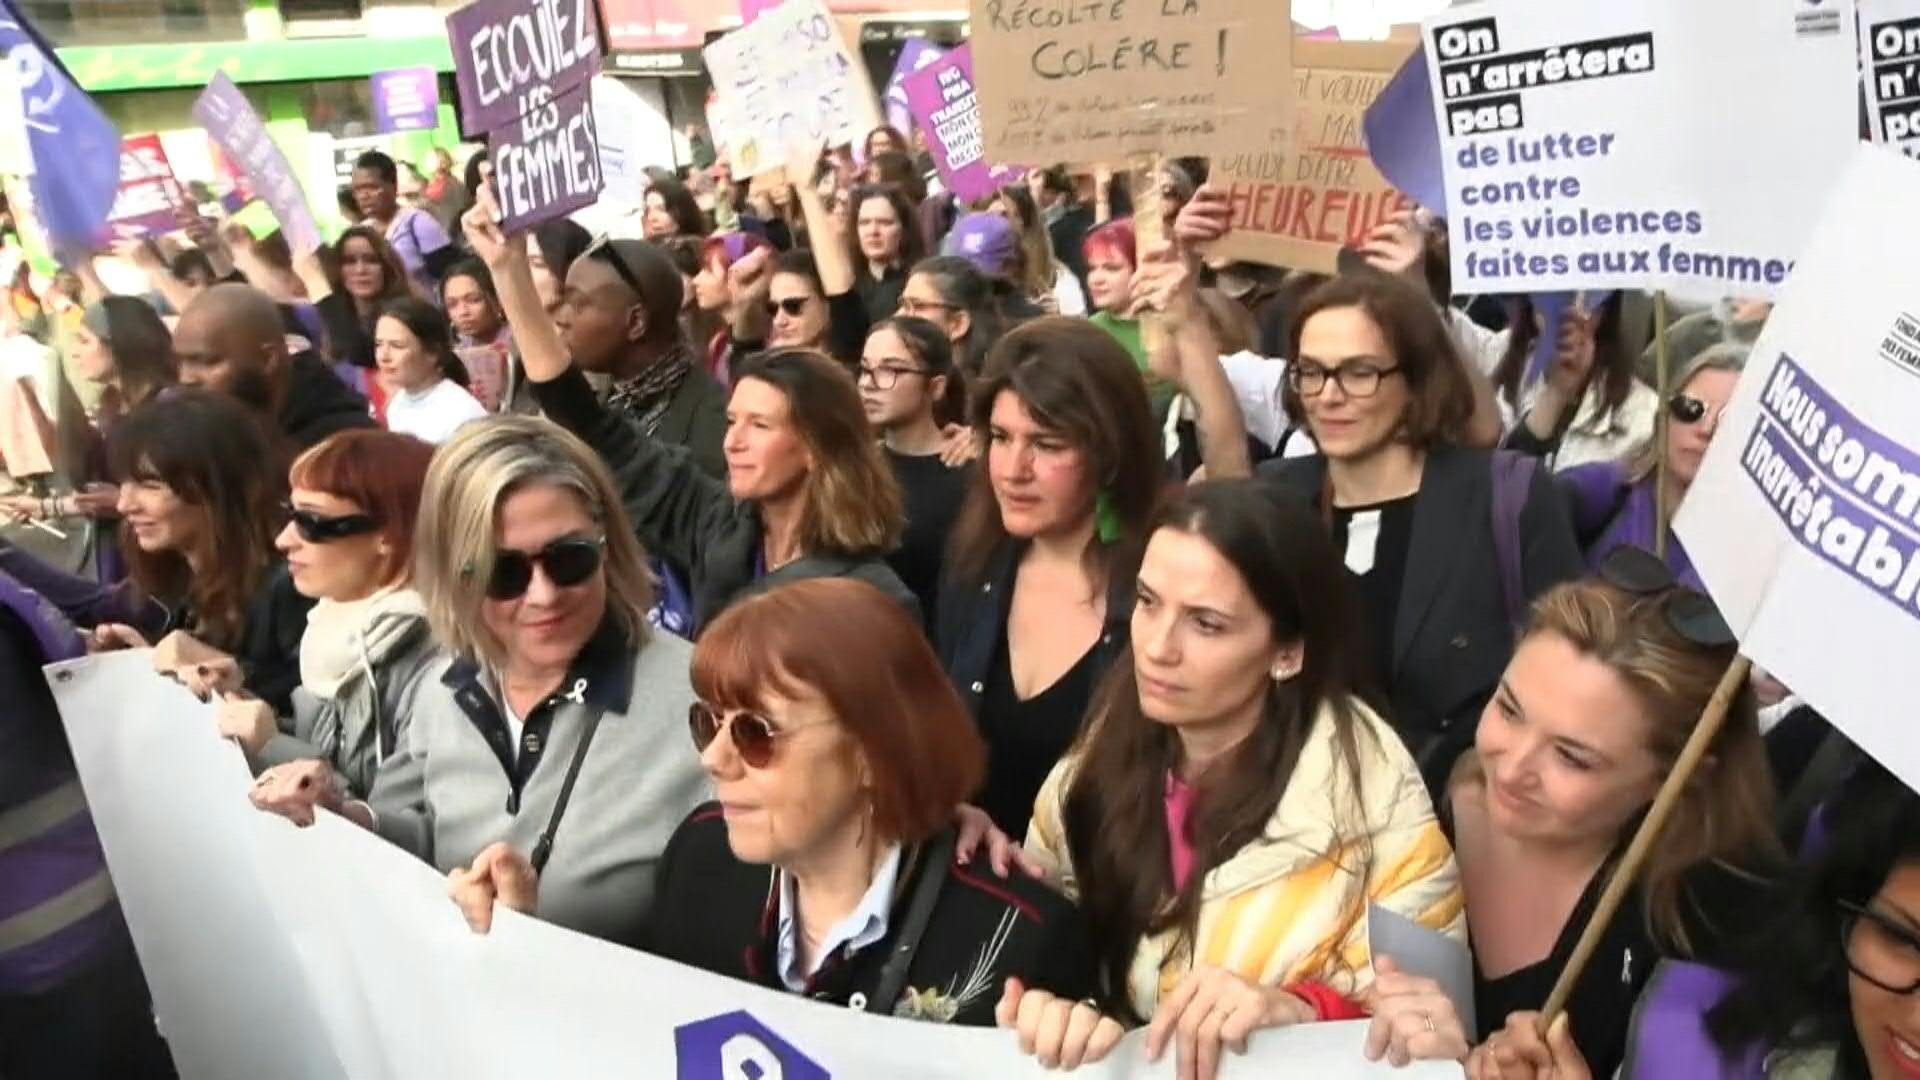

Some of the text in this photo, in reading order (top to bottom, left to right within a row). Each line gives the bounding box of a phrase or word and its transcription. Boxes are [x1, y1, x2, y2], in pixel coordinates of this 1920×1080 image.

[1439, 27, 1494, 57] On
[1445, 43, 1650, 97] n'arrêtera
[519, 84, 559, 142] LES
[1451, 103, 1519, 137] pas
[496, 101, 600, 221] FEMMES
[1457, 132, 1615, 168] de lutter
[1461, 175, 1580, 206] contre
[1463, 207, 1702, 242] les violences
[1465, 242, 1796, 284] faites aux femme
[1765, 362, 1827, 447] Nous
[1746, 418, 1920, 613] inarrêtabl
